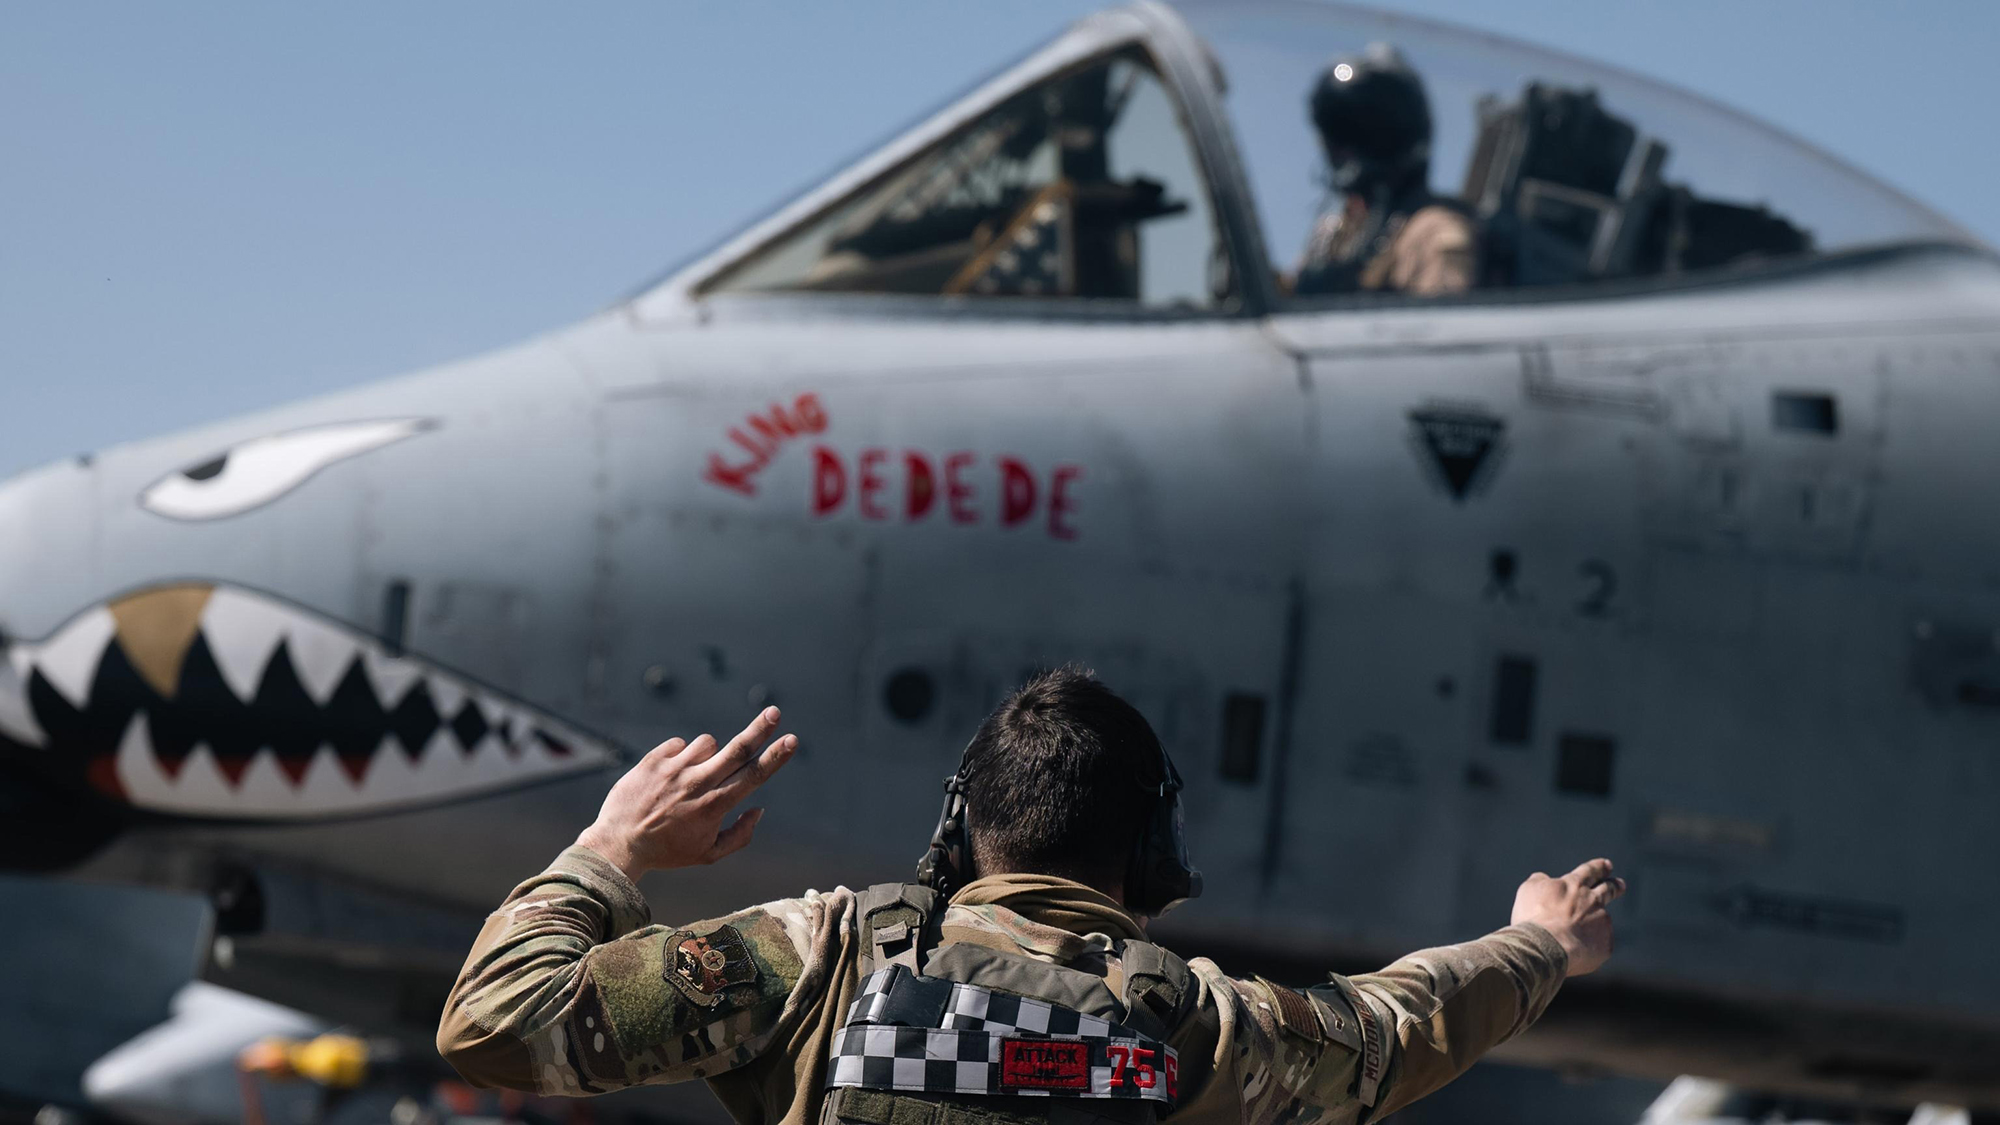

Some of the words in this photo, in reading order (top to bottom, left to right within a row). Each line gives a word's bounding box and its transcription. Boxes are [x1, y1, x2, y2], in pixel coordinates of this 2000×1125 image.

[704, 392, 829, 497] KING
[1013, 1046, 1077, 1064] ATTACK
[1106, 1045, 1156, 1089] 75
